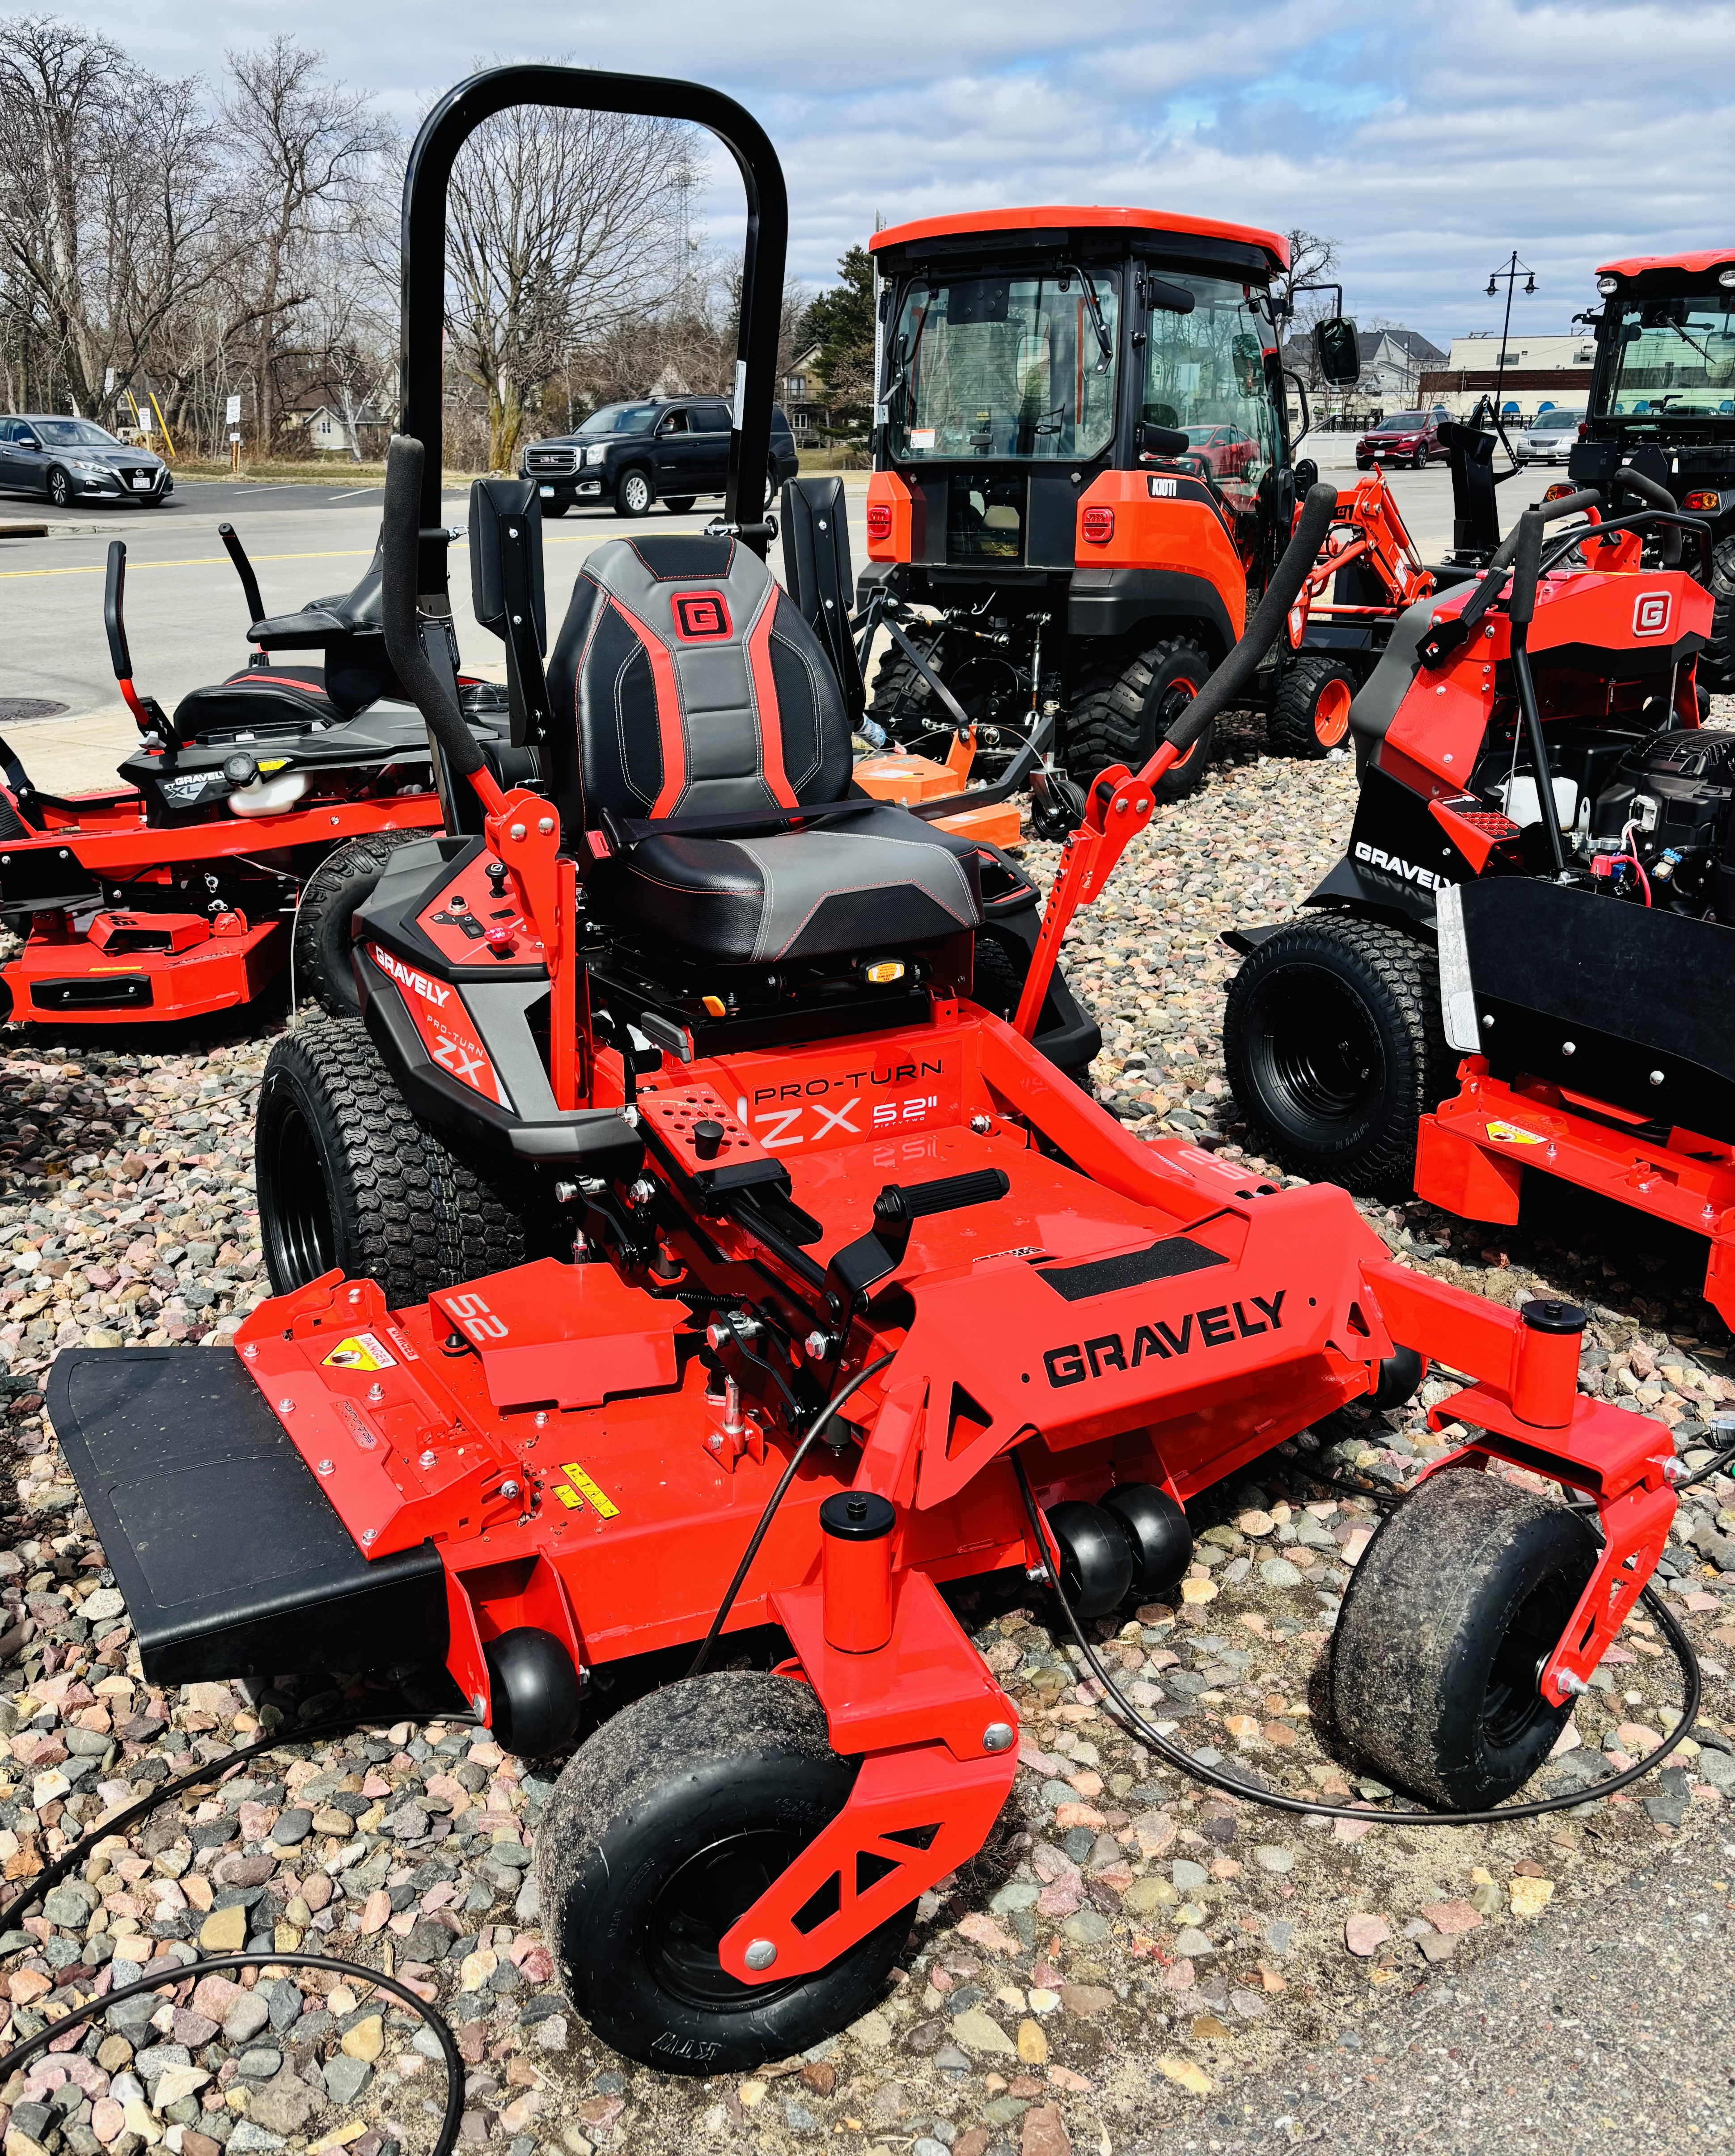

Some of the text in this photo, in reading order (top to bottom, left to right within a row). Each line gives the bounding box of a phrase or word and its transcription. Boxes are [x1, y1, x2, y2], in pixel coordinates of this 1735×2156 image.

[1152, 478, 1176, 496] KIOTI
[169, 786, 200, 798] XL
[375, 945, 450, 1008] GRAVELY
[427, 1015, 483, 1057] PRO-TURN
[433, 1035, 486, 1088] ZX
[755, 1059, 944, 1105] PRO-TURN
[755, 1097, 862, 1149] ZX
[1499, 1123, 1540, 1140] DANGER
[445, 1293, 508, 1341] 52
[1043, 1289, 1286, 1388] GRAVELY
[360, 1337, 390, 1364] DANGER
